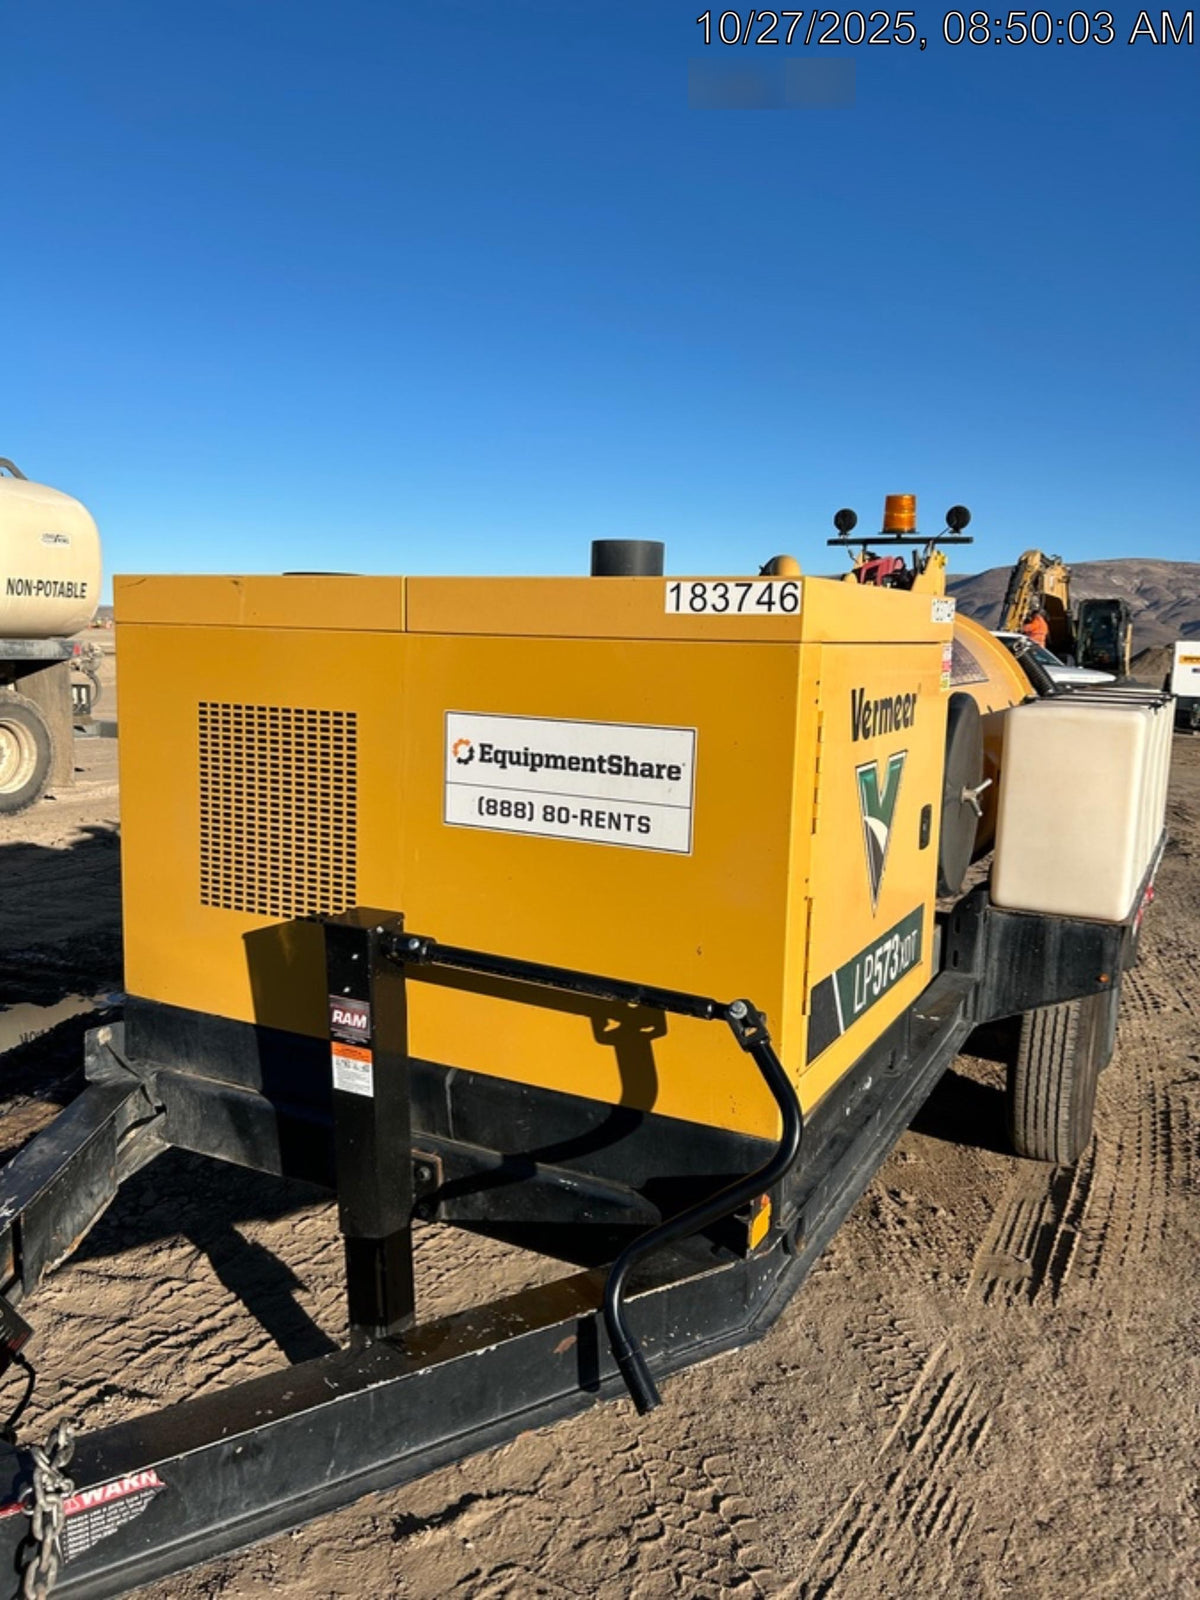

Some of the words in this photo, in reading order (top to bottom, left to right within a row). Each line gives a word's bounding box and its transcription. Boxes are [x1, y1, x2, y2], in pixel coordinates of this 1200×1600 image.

[6, 577, 88, 599] NON-POTABLE
[668, 581, 800, 613] 183746
[851, 687, 917, 742] Vermeer
[478, 742, 682, 781] EquipmentShare
[477, 796, 535, 822] (888)
[542, 804, 651, 835] 80-RENTS
[331, 1008, 367, 1029] RAM
